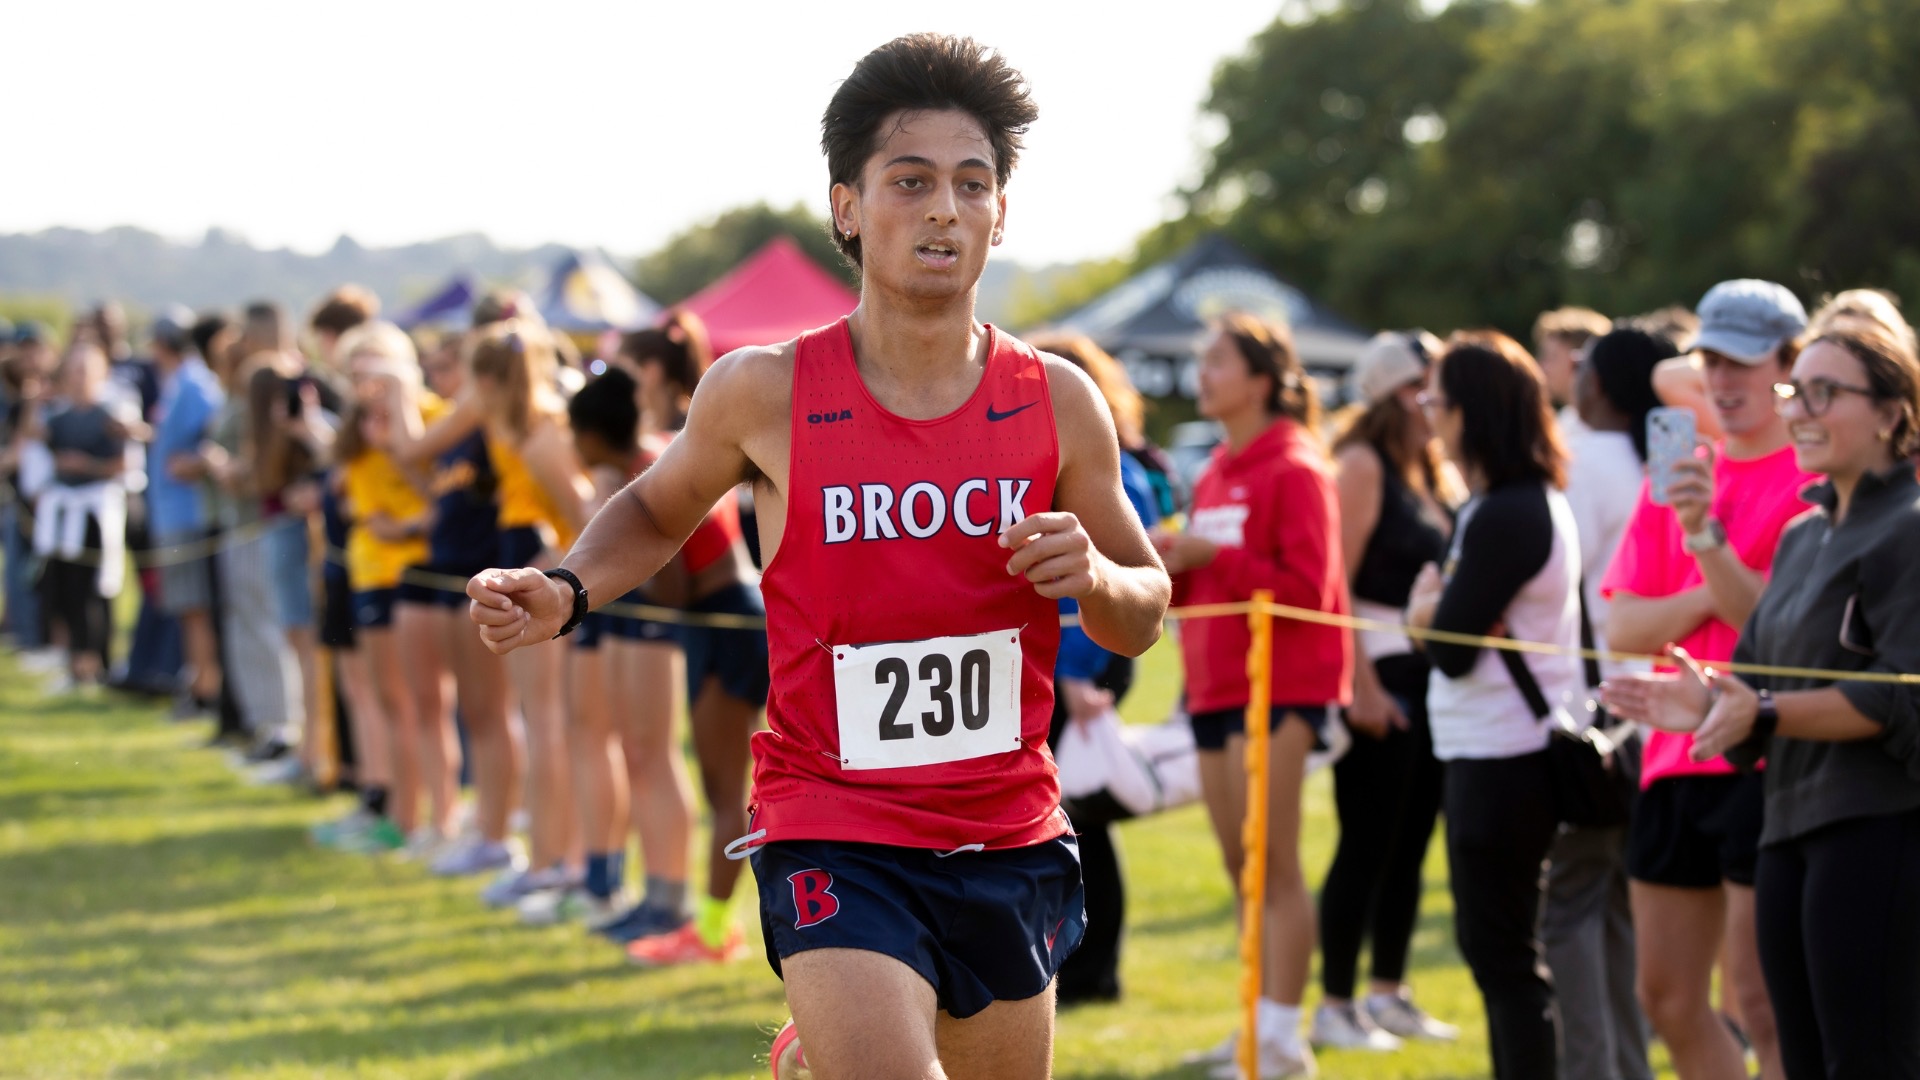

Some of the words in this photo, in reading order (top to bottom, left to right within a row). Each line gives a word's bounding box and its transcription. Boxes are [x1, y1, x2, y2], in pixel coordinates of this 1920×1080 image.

[807, 410, 853, 424] OUA
[821, 478, 1032, 544] BROCK
[874, 648, 991, 741] 230
[787, 868, 839, 930] B
